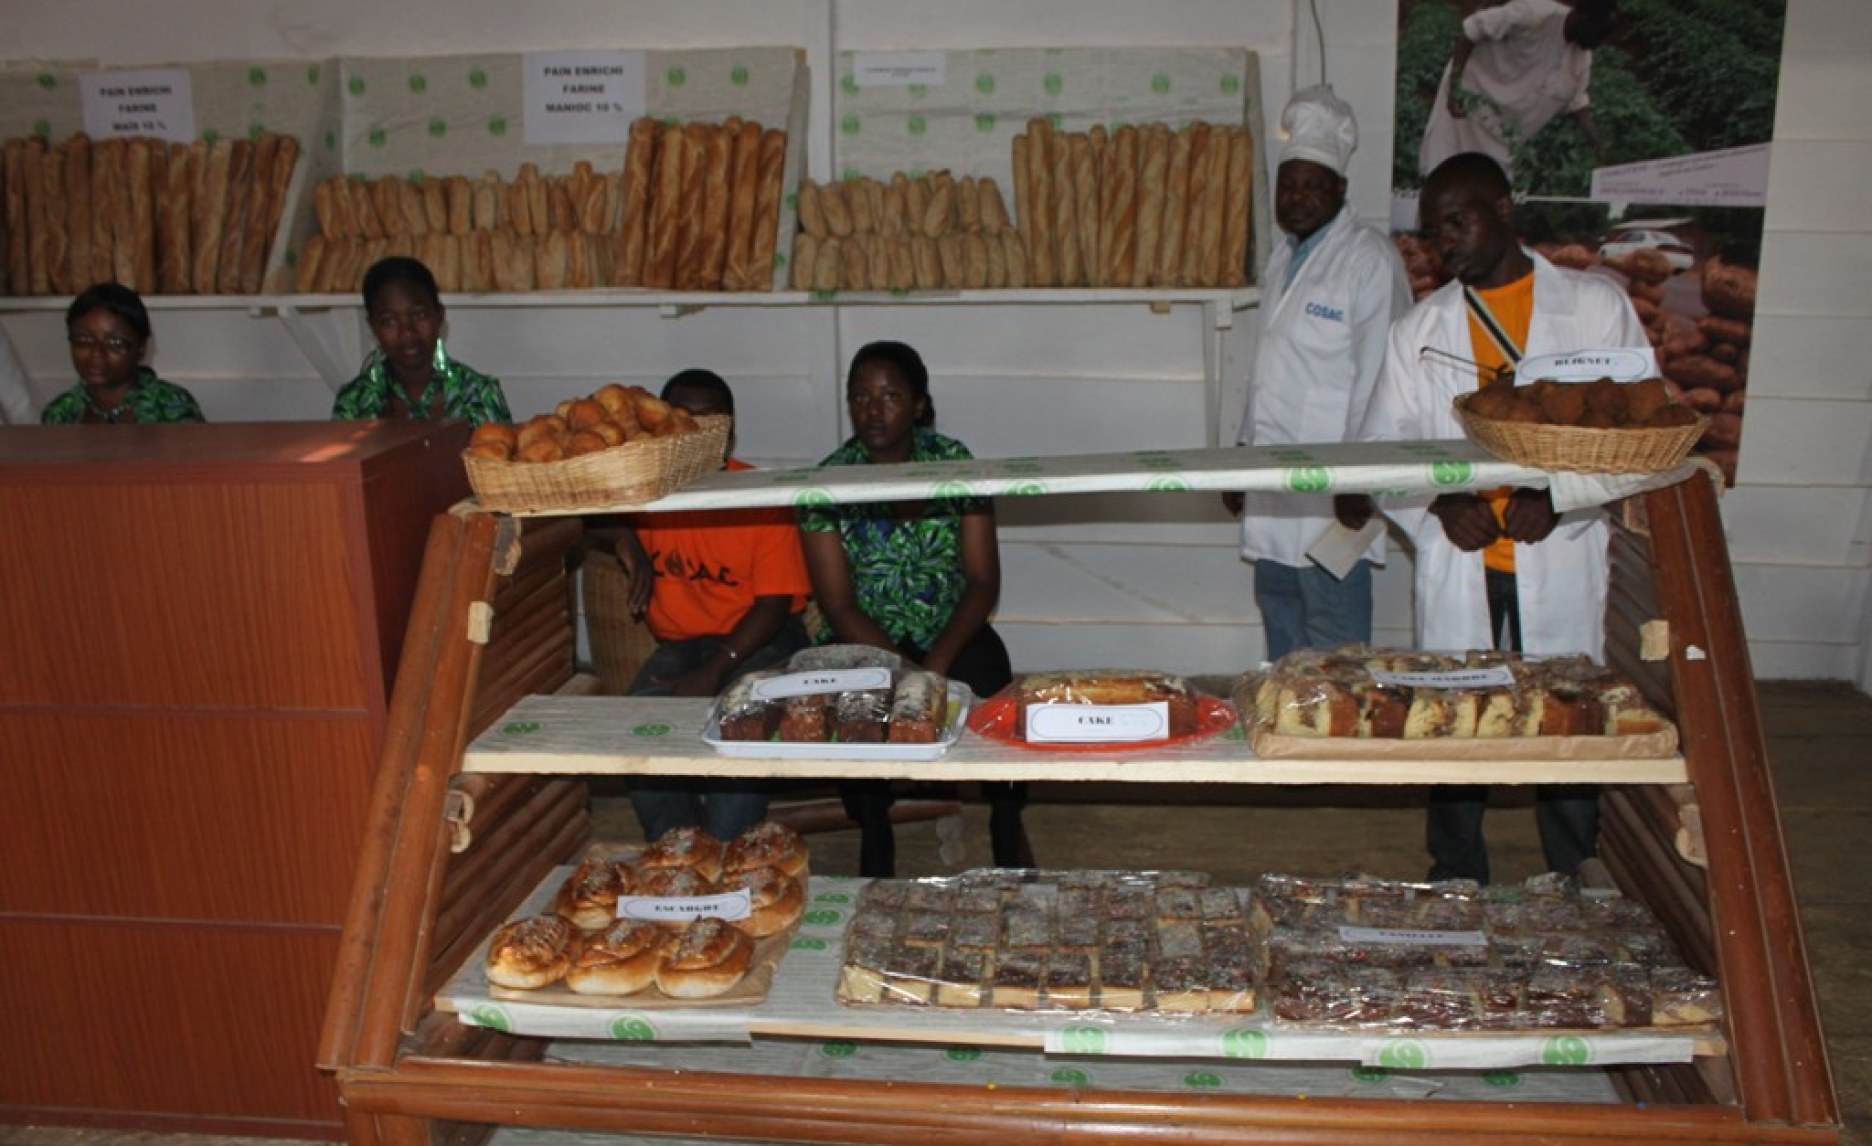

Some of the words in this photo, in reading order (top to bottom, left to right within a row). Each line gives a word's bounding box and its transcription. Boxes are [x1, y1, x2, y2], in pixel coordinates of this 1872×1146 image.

[544, 66, 571, 76] PAIN
[575, 65, 624, 76] ENRICHI
[99, 87, 125, 97] PAIN
[127, 85, 172, 96] ENRICHI
[562, 84, 605, 94] FARINE
[118, 103, 157, 113] FARINE
[1305, 301, 1344, 323] COSAC
[1078, 716, 1112, 725] CAKE
